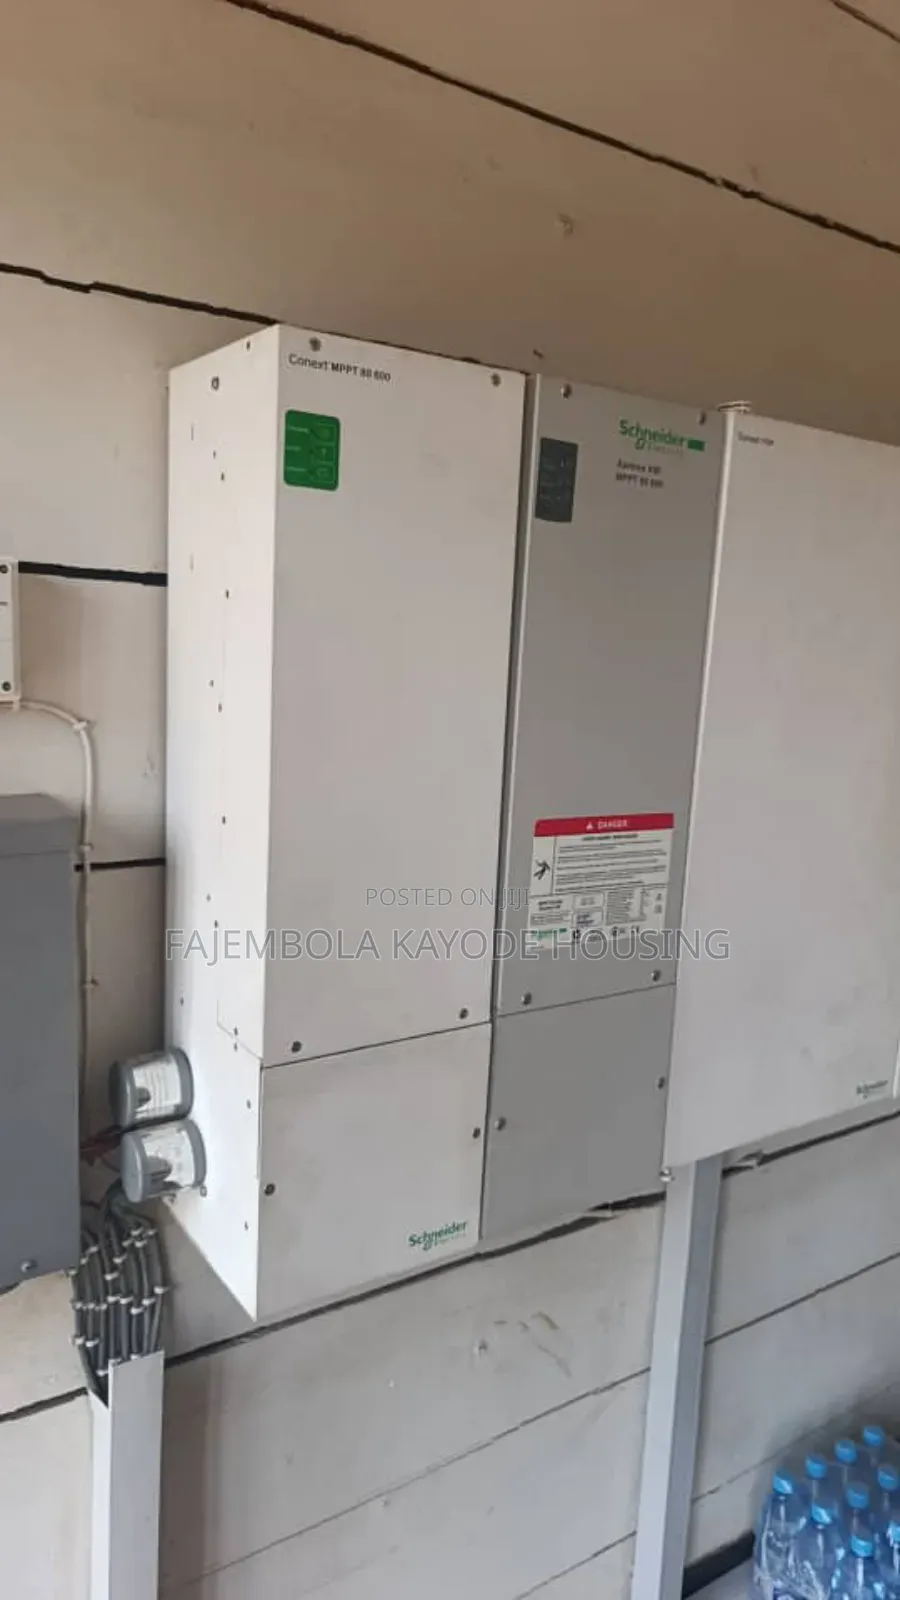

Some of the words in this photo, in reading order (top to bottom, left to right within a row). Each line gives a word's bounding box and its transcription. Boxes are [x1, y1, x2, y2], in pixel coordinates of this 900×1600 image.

[288, 353, 328, 371] Conext
[331, 362, 358, 375] MPPT
[619, 419, 685, 449] Schneider
